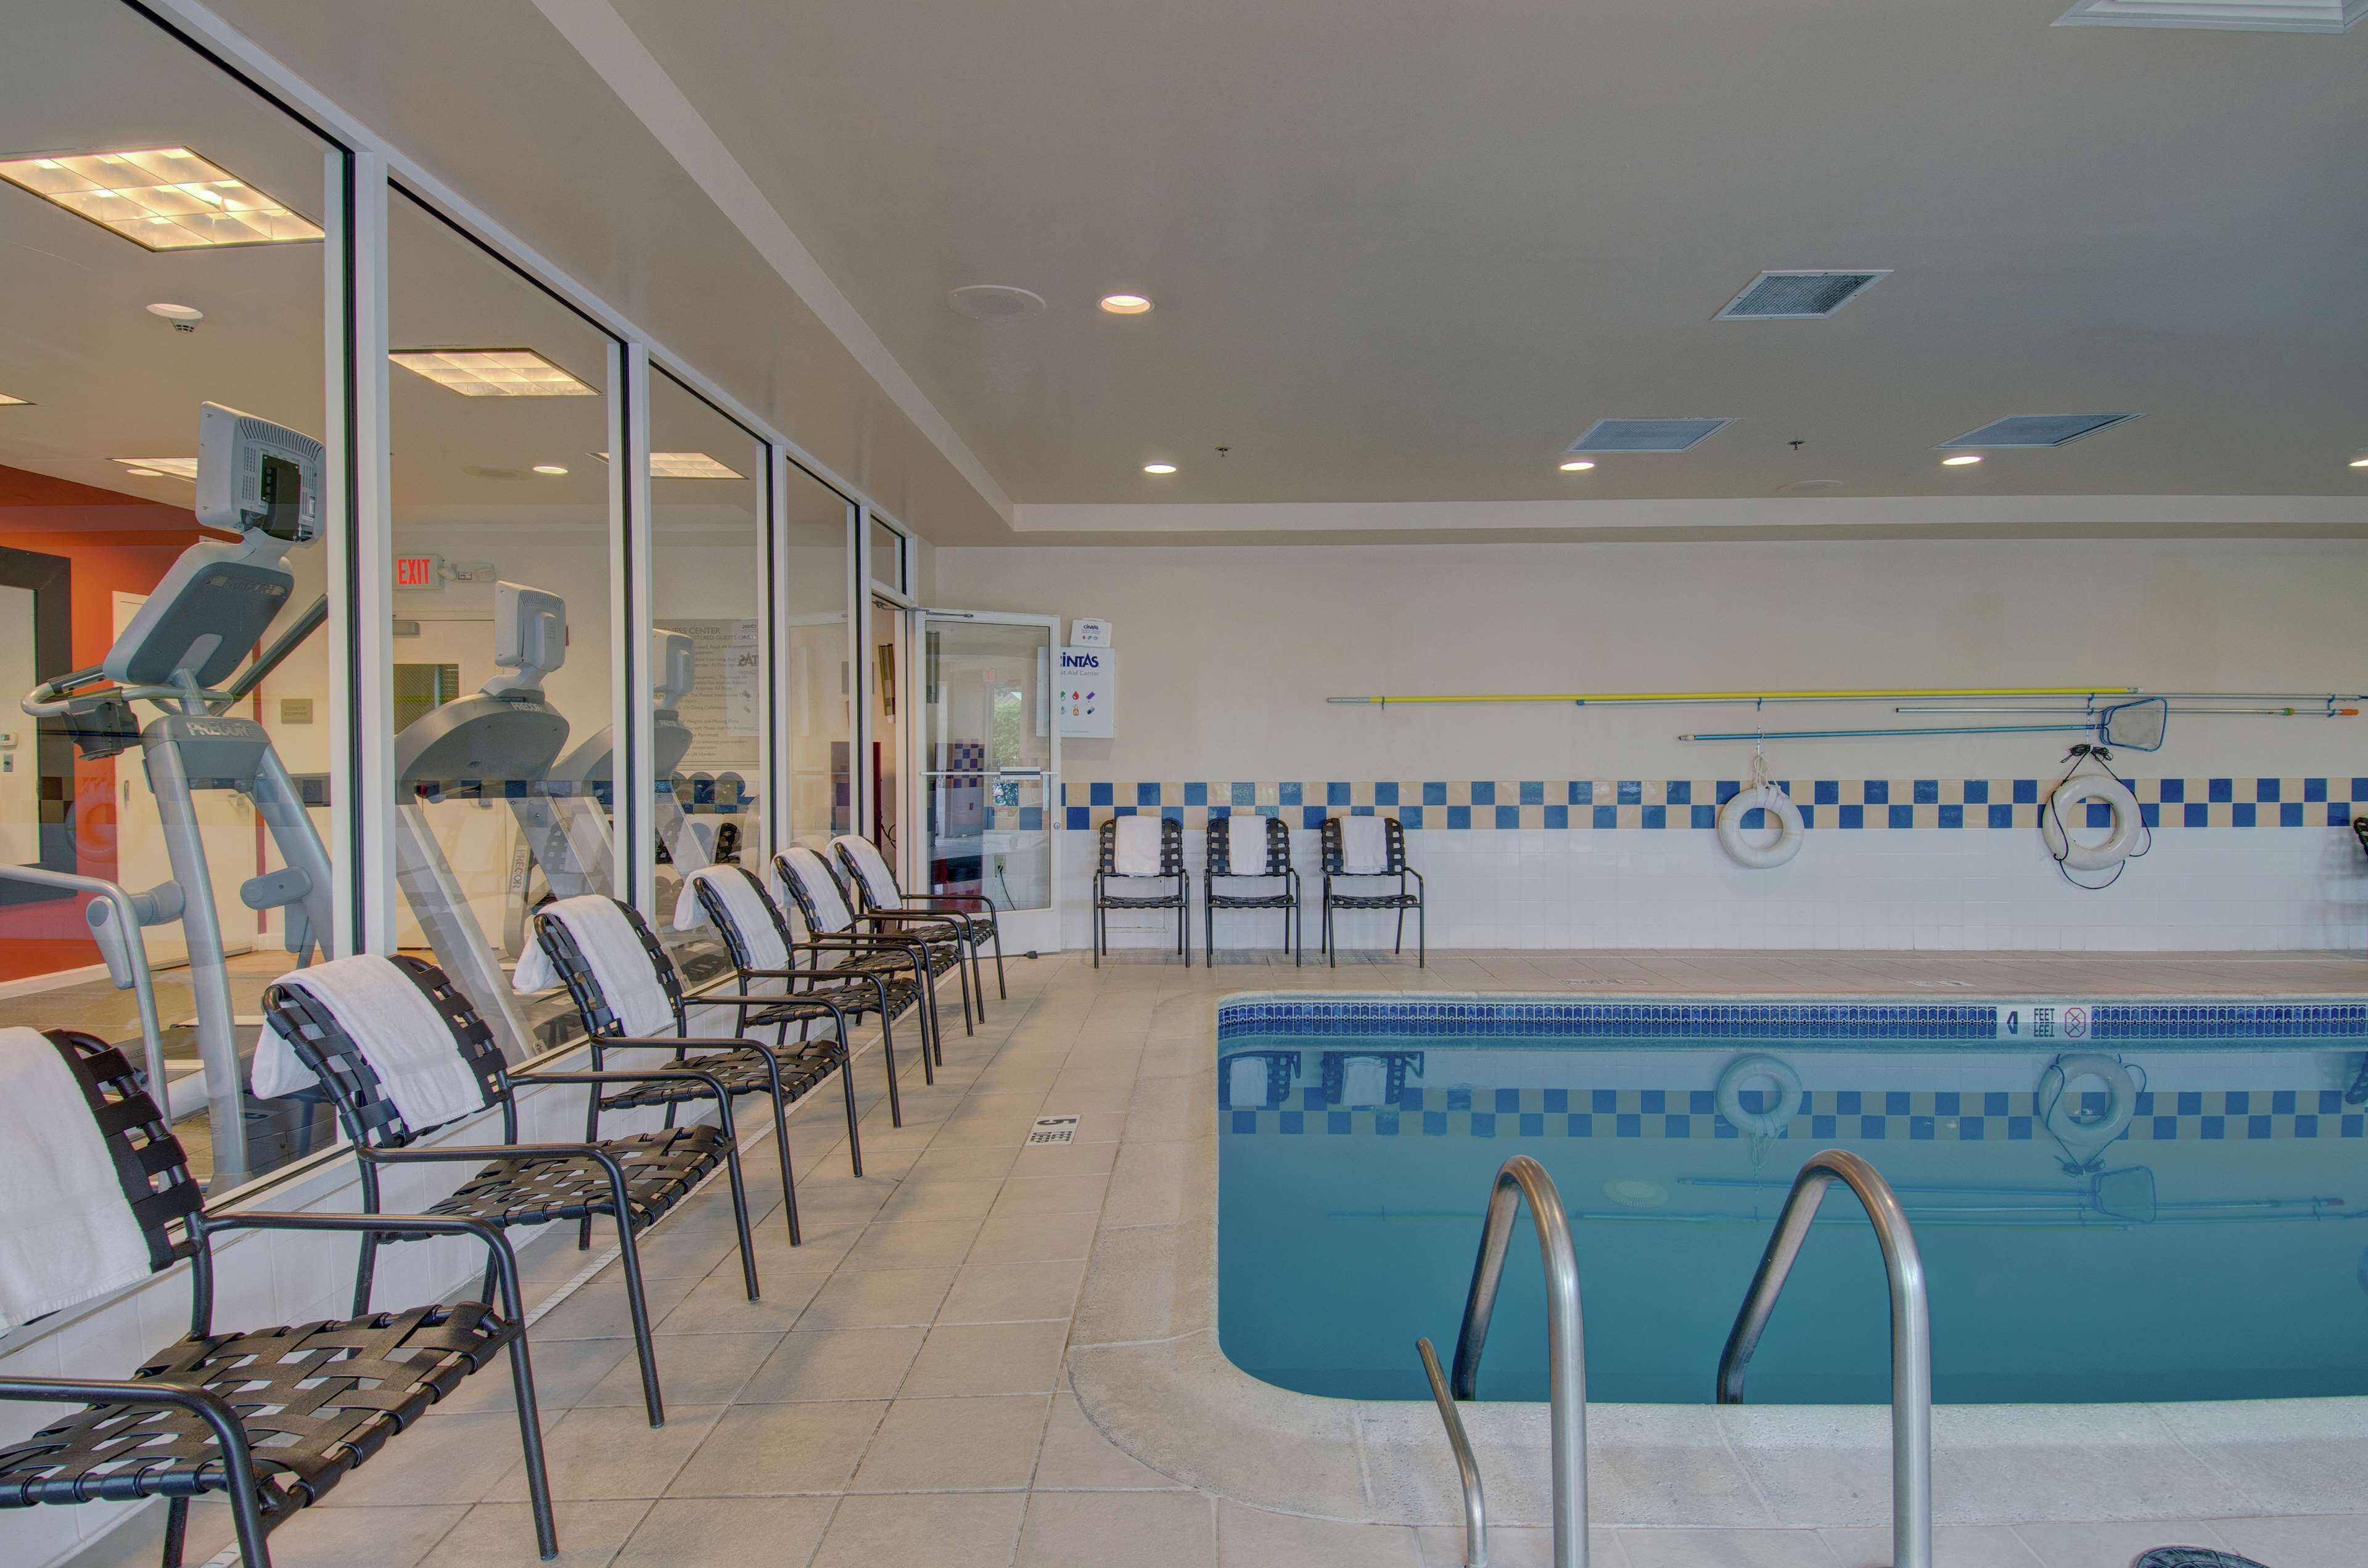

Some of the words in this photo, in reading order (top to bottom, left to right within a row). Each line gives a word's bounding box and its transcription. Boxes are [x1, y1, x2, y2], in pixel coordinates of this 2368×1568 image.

[397, 559, 430, 585] EXIT
[1061, 652, 1099, 668] INTAS
[510, 701, 543, 712] PRECOR
[512, 848, 526, 889] PRECOR
[2034, 1008, 2055, 1021] FEET
